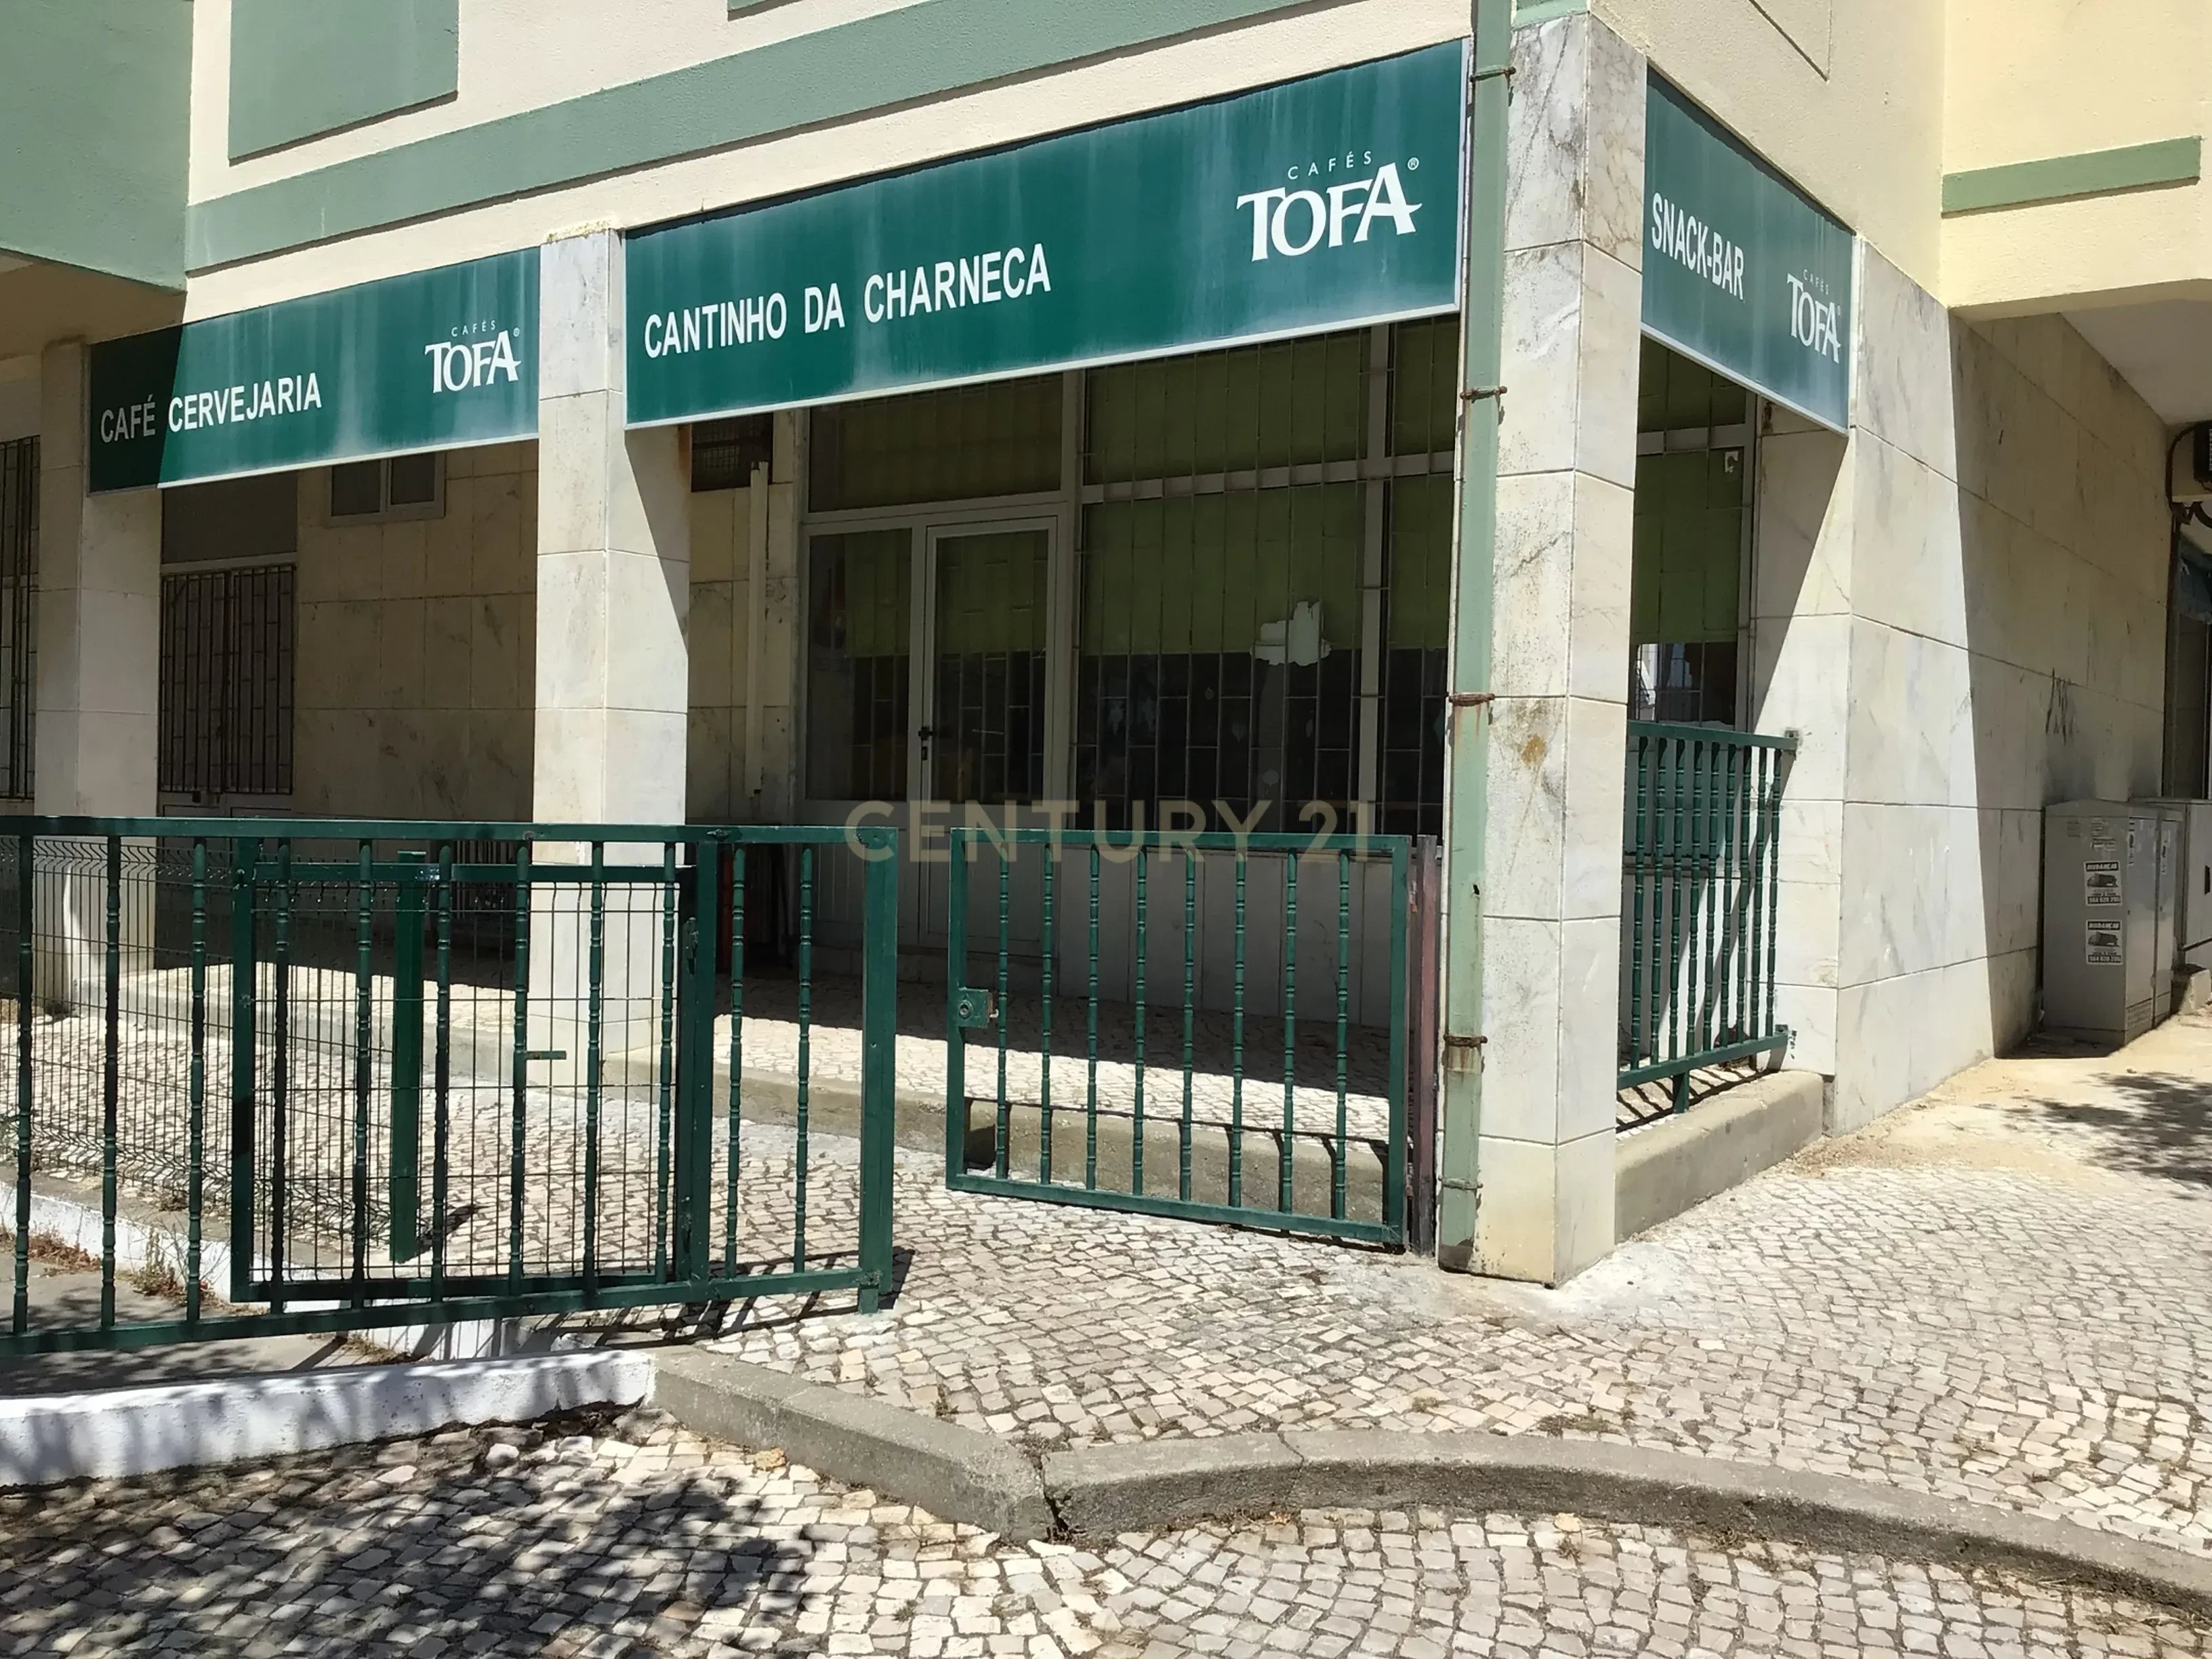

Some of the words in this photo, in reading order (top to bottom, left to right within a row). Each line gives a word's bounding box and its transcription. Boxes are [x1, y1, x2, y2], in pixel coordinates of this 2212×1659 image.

[1288, 151, 1371, 180] CAFÉS
[1236, 162, 1422, 262] TOFA
[1652, 192, 1744, 300] SNACK-BAR
[451, 319, 495, 337] CAFÉS
[644, 292, 787, 359] CANTINHO
[804, 283, 845, 333] DA
[864, 243, 1051, 323] CHARNECA
[1787, 273, 1841, 364] TOFA
[424, 330, 522, 393] TOFA
[101, 394, 156, 443] CAFÉ
[169, 372, 322, 432] CERVEJARIA
